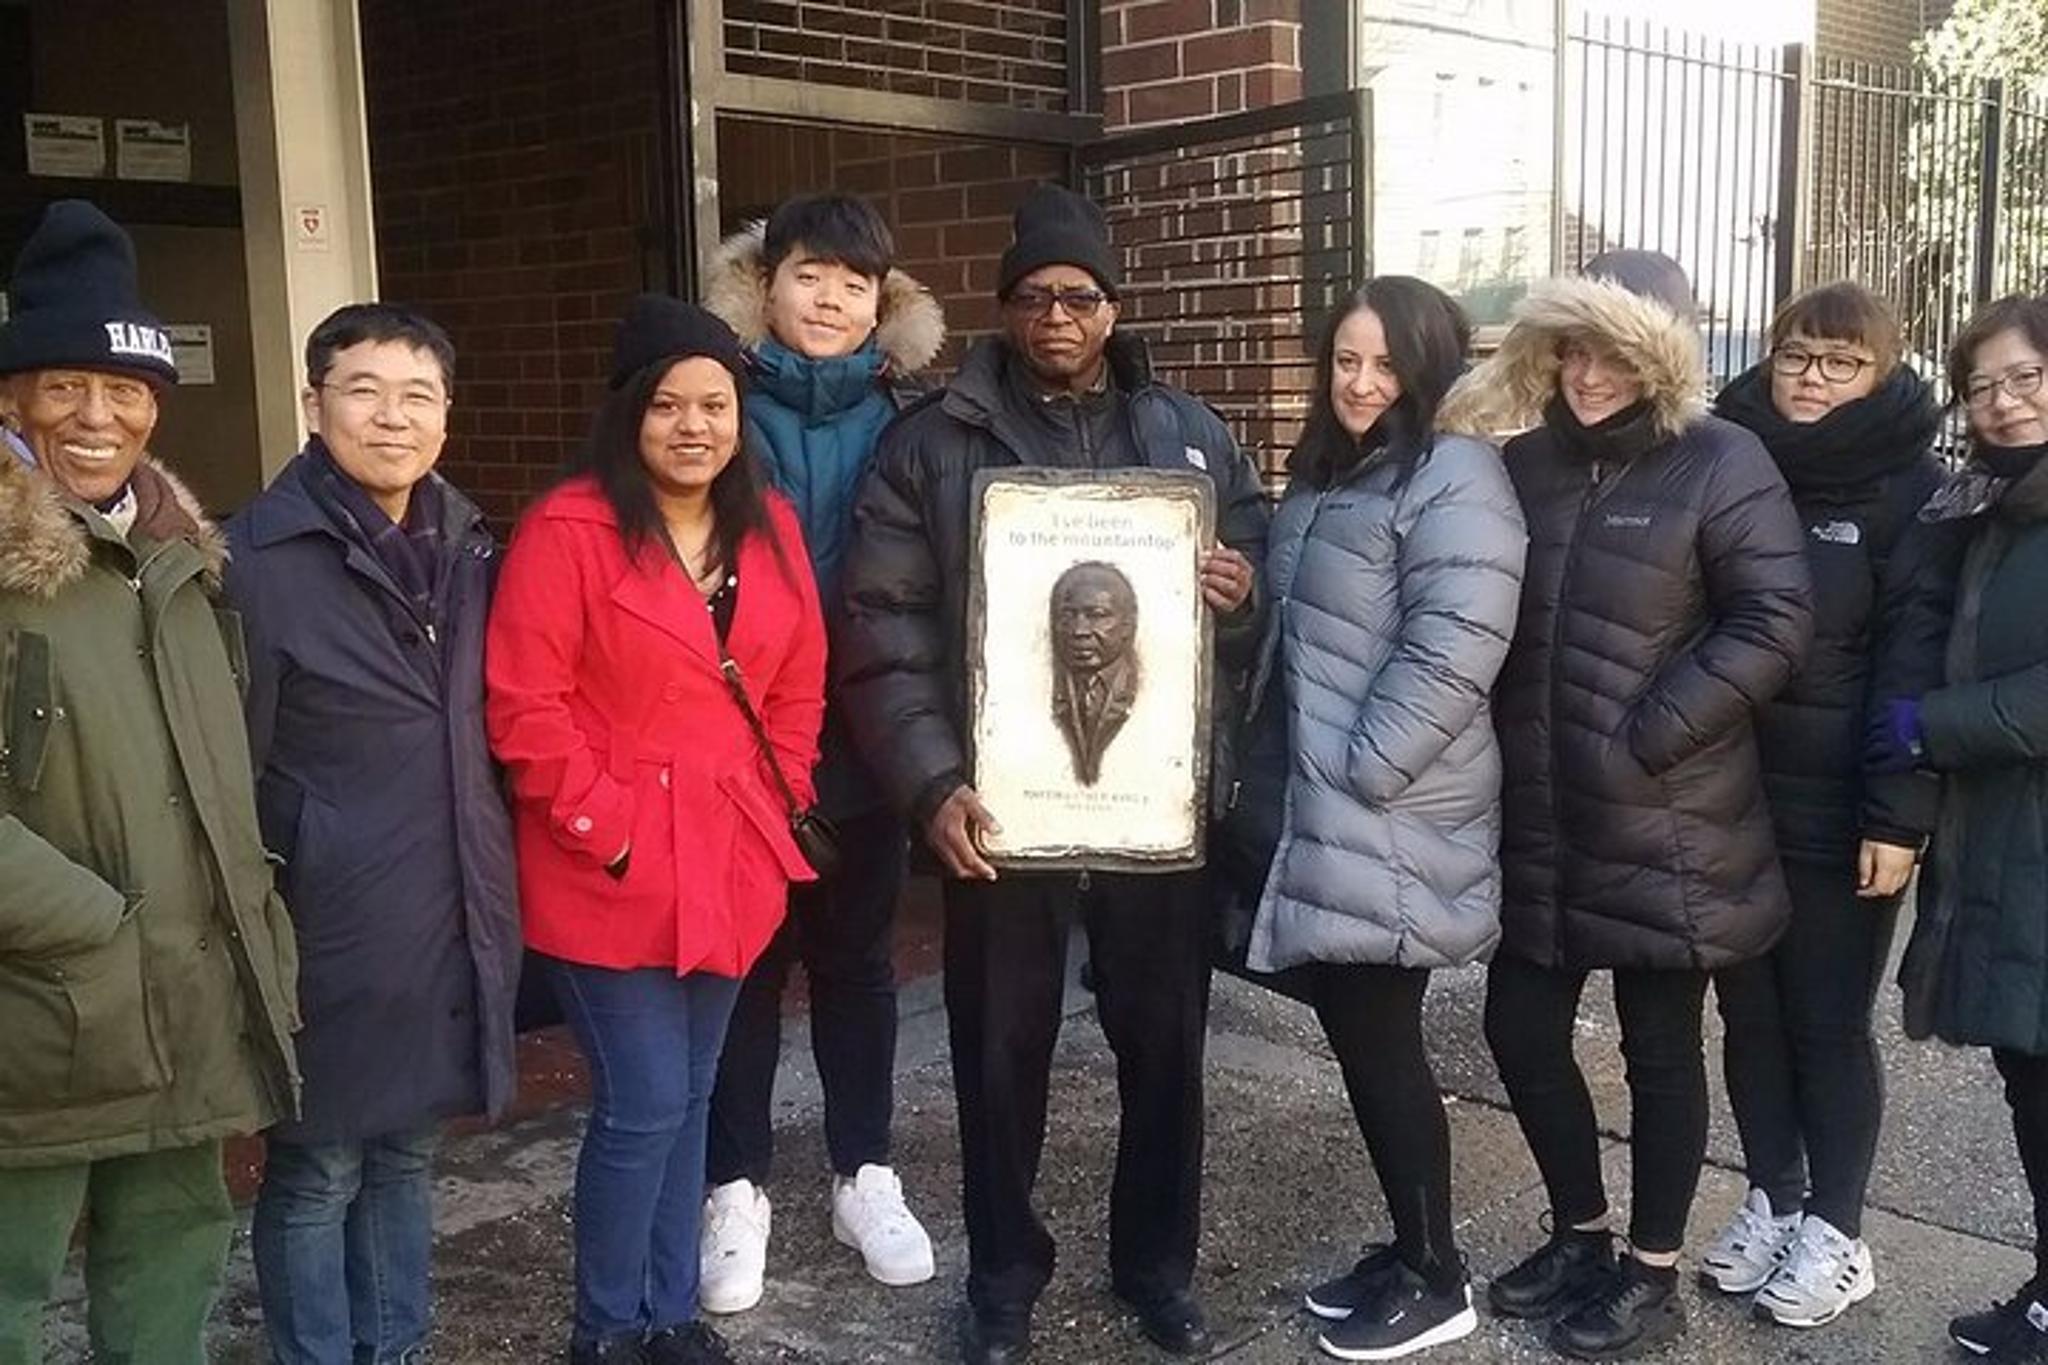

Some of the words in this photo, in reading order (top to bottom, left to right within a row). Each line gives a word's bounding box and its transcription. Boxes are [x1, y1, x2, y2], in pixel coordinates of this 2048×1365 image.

[1089, 511, 1133, 529] been
[1009, 531, 1027, 546] to
[1031, 531, 1058, 546] the
